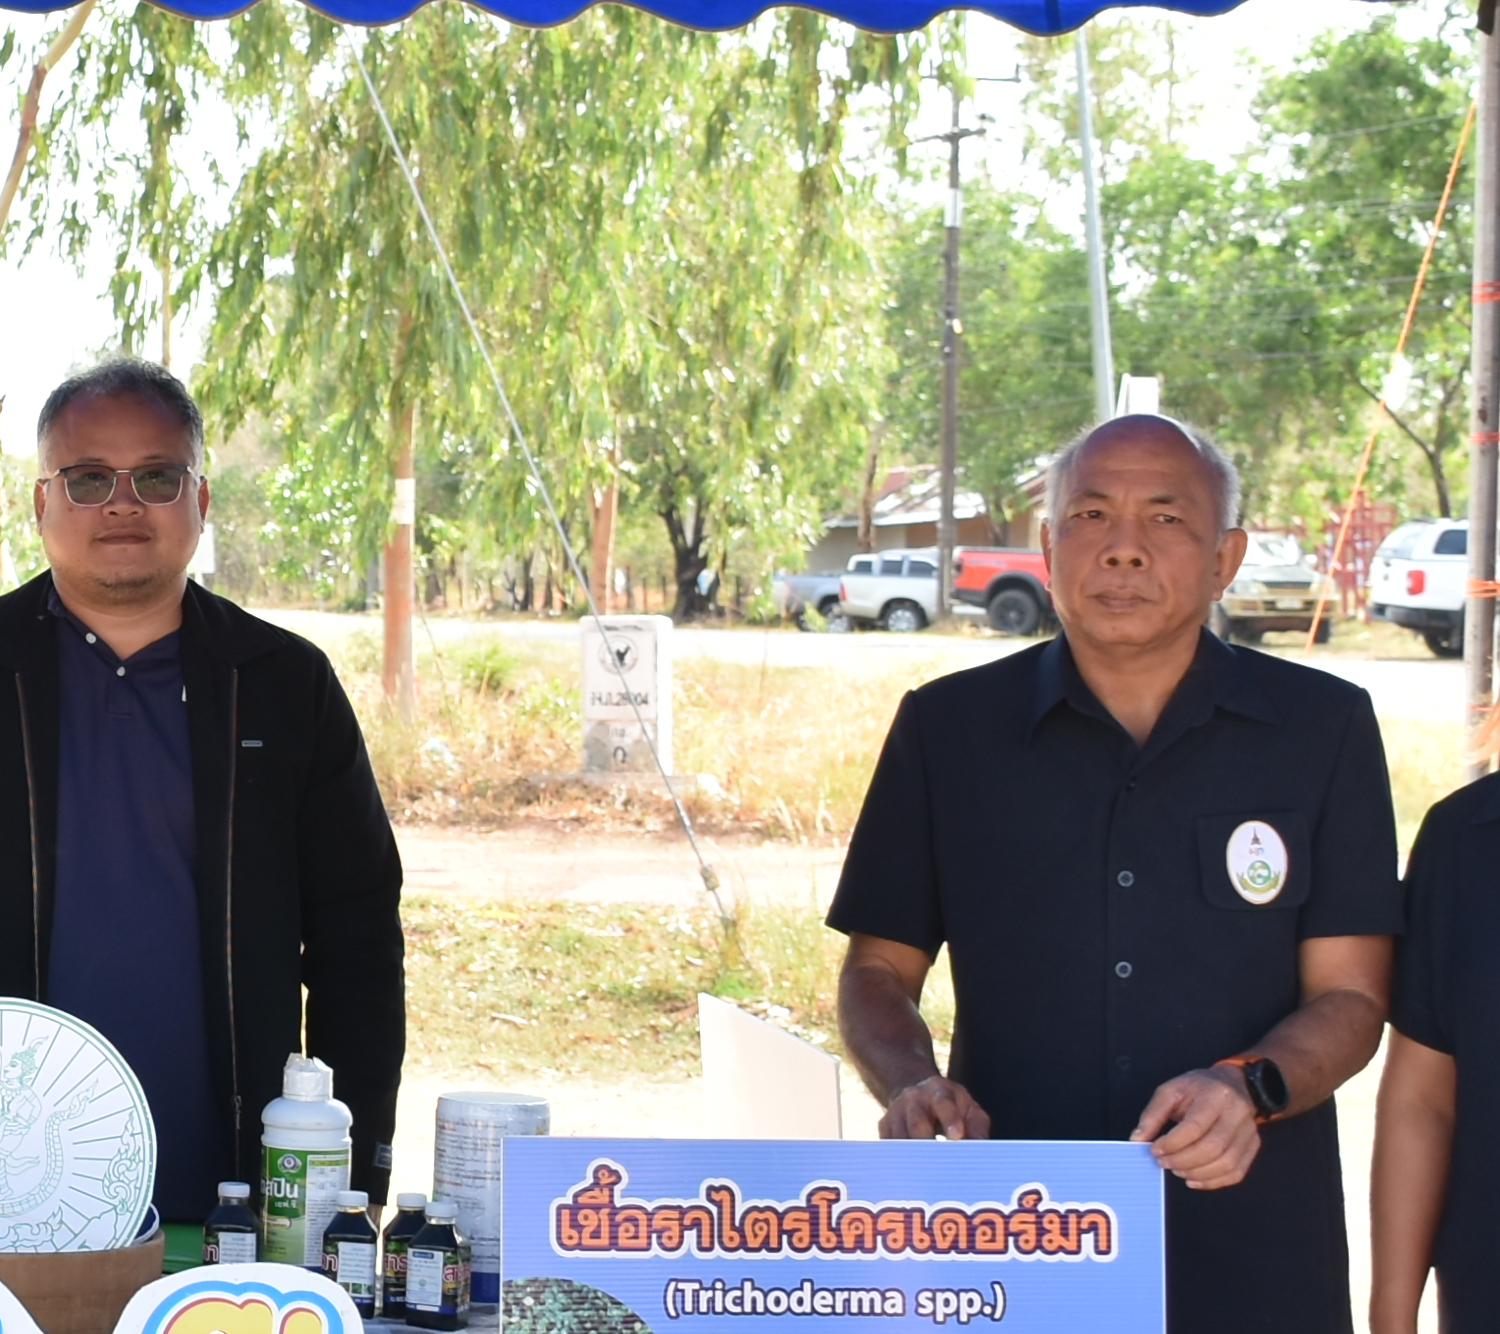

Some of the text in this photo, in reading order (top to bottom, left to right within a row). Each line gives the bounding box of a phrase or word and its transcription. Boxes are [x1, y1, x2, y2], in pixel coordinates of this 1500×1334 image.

[561, 1164, 1109, 1253] เชื้อราไตรโครเดอร์มา
[666, 1281, 1006, 1322] (Trichoderma spp.)
